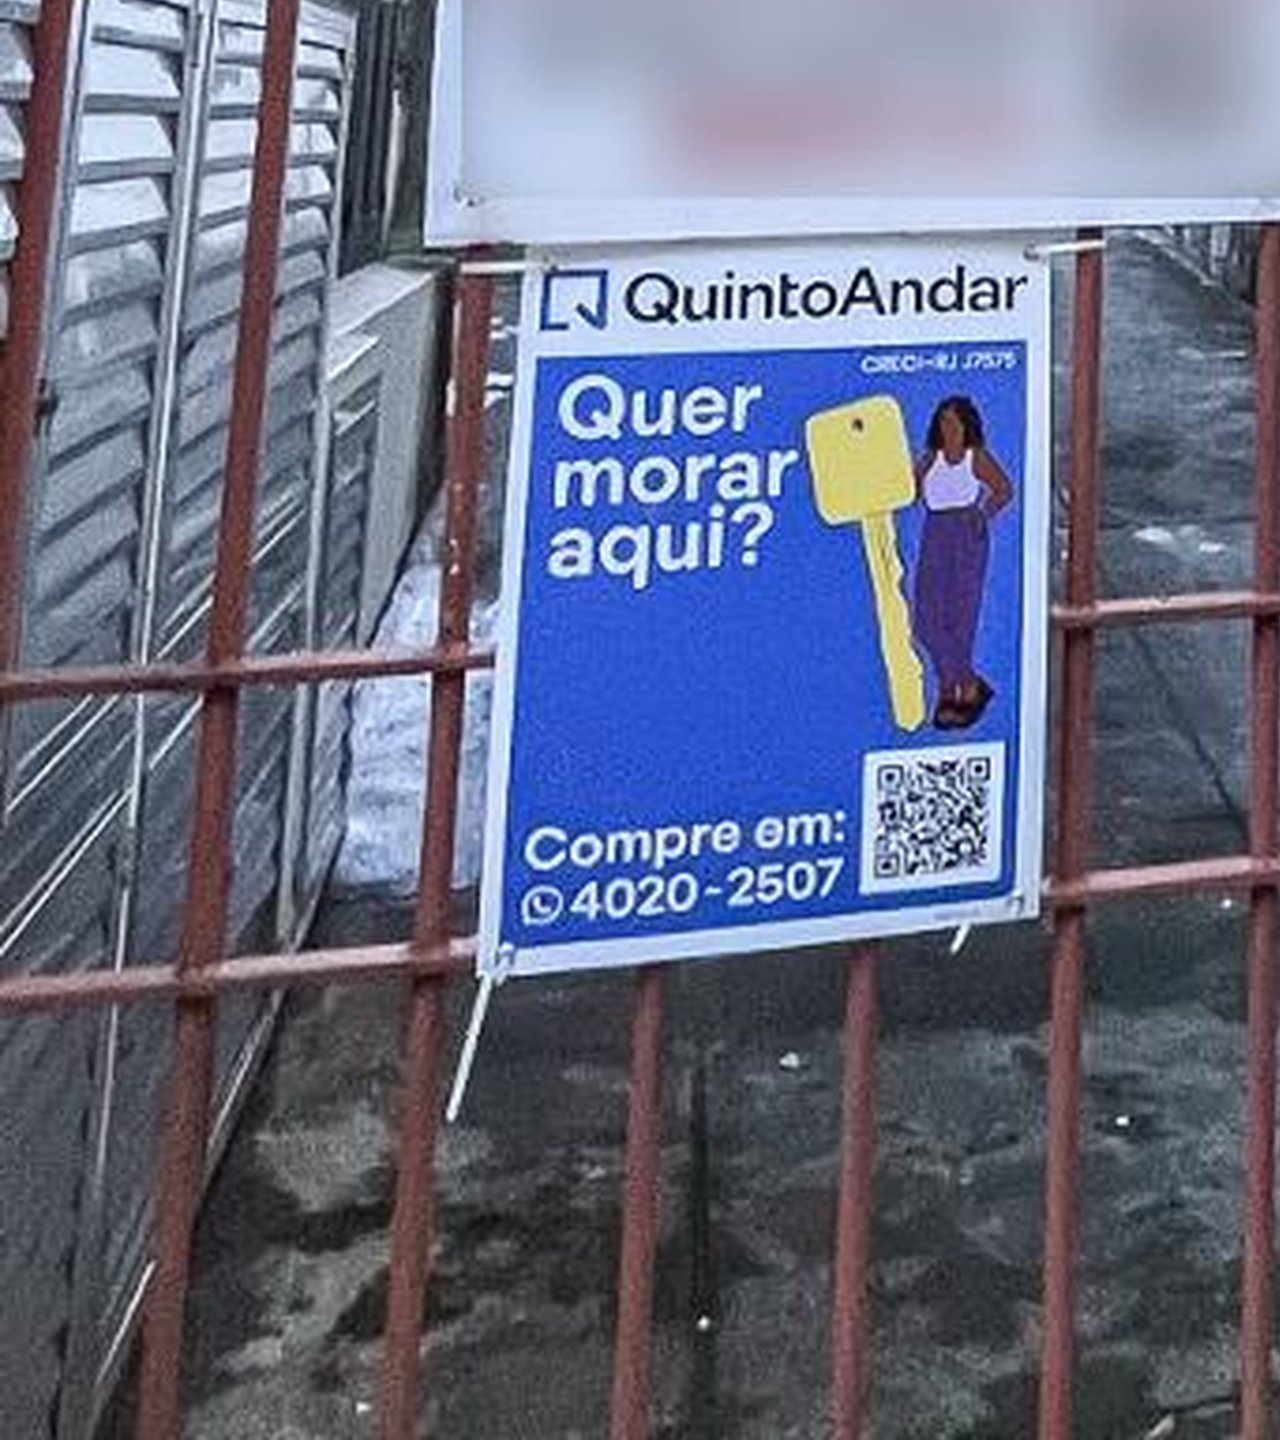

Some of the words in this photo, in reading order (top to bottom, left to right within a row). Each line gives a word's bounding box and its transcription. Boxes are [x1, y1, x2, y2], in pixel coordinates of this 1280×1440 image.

[624, 265, 1028, 325] QuintoAndar
[557, 373, 762, 440] Quer
[553, 446, 799, 508] morar
[546, 502, 774, 589] aqui?
[523, 820, 741, 870] Compre
[754, 810, 846, 849] em:
[569, 857, 845, 920] 4020-2507
